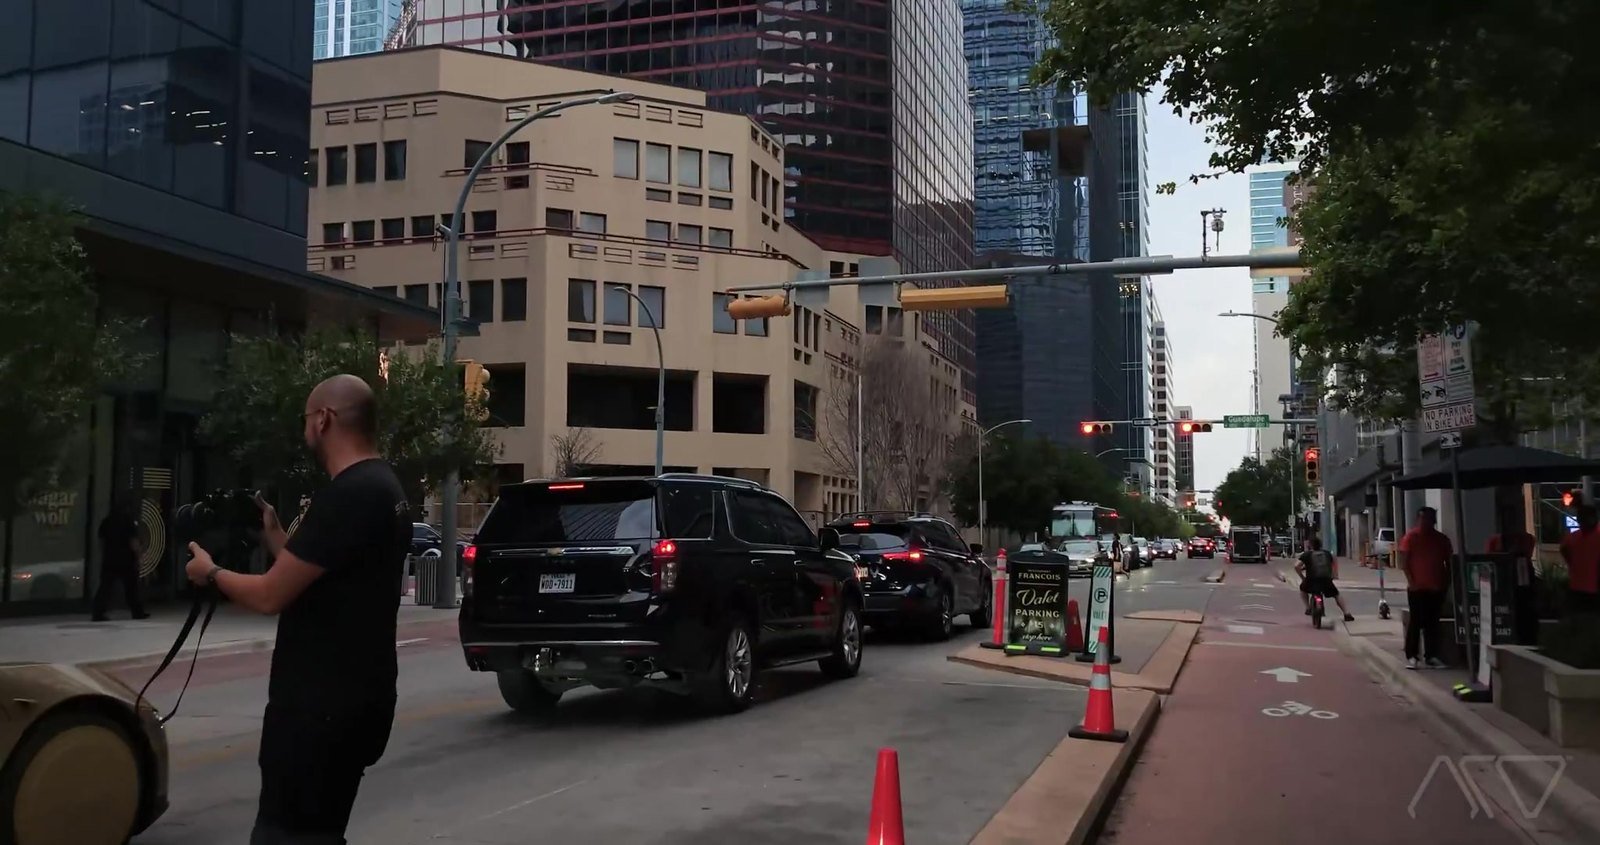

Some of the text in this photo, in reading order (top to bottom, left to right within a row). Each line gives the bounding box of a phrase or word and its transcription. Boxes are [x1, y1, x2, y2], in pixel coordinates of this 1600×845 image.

[1425, 405, 1472, 420] NO PARKING
[1228, 415, 1265, 423] Guadalupe
[1425, 415, 1474, 431] IN BIKE LANE
[1018, 572, 1061, 581] FRANCOIS
[1016, 588, 1060, 606] Valet
[1015, 608, 1060, 618] PARKING
